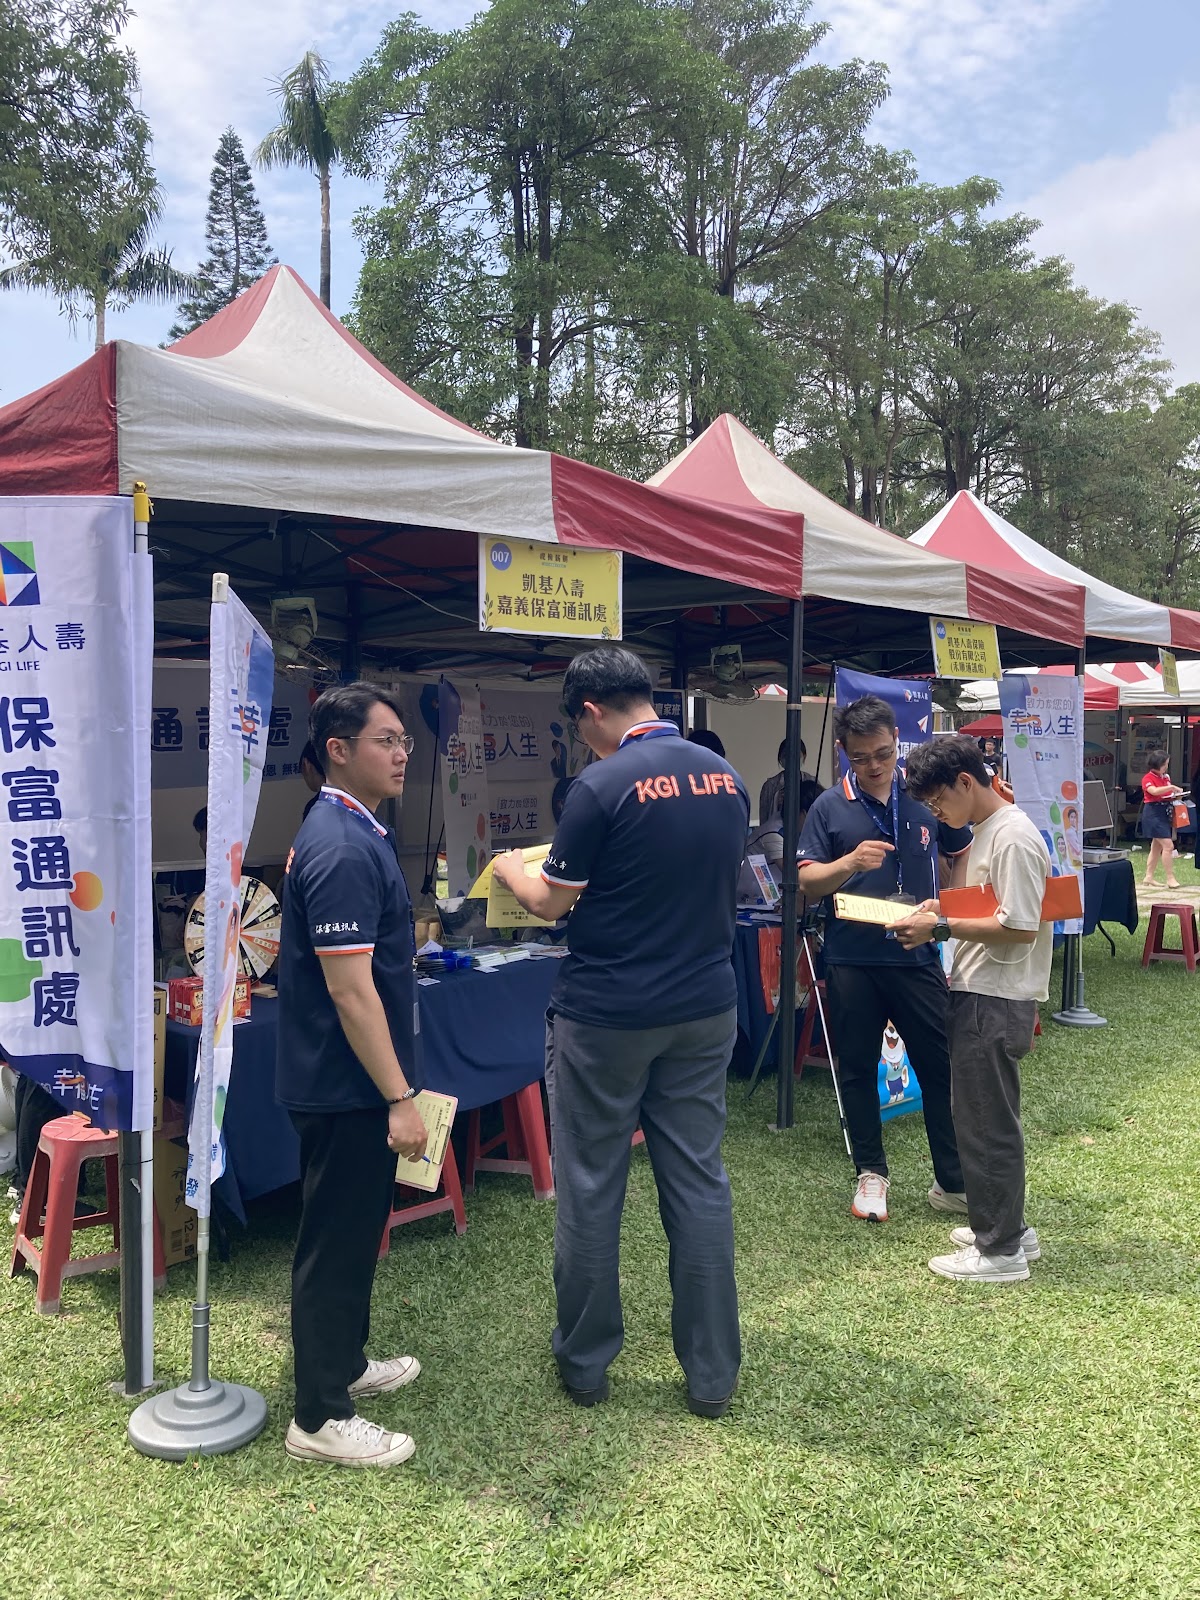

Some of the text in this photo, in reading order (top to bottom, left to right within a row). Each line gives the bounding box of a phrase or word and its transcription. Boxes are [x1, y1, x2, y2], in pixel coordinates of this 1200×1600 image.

[492, 550, 509, 563] 007
[522, 573, 585, 598] 凱基人壽
[497, 595, 607, 622] 嘉義保富通訊處
[16, 660, 41, 671] LIFE
[1010, 709, 1075, 736] 幸福人生
[448, 735, 483, 774] 幸福人生
[635, 773, 738, 804] KGI LIFE
